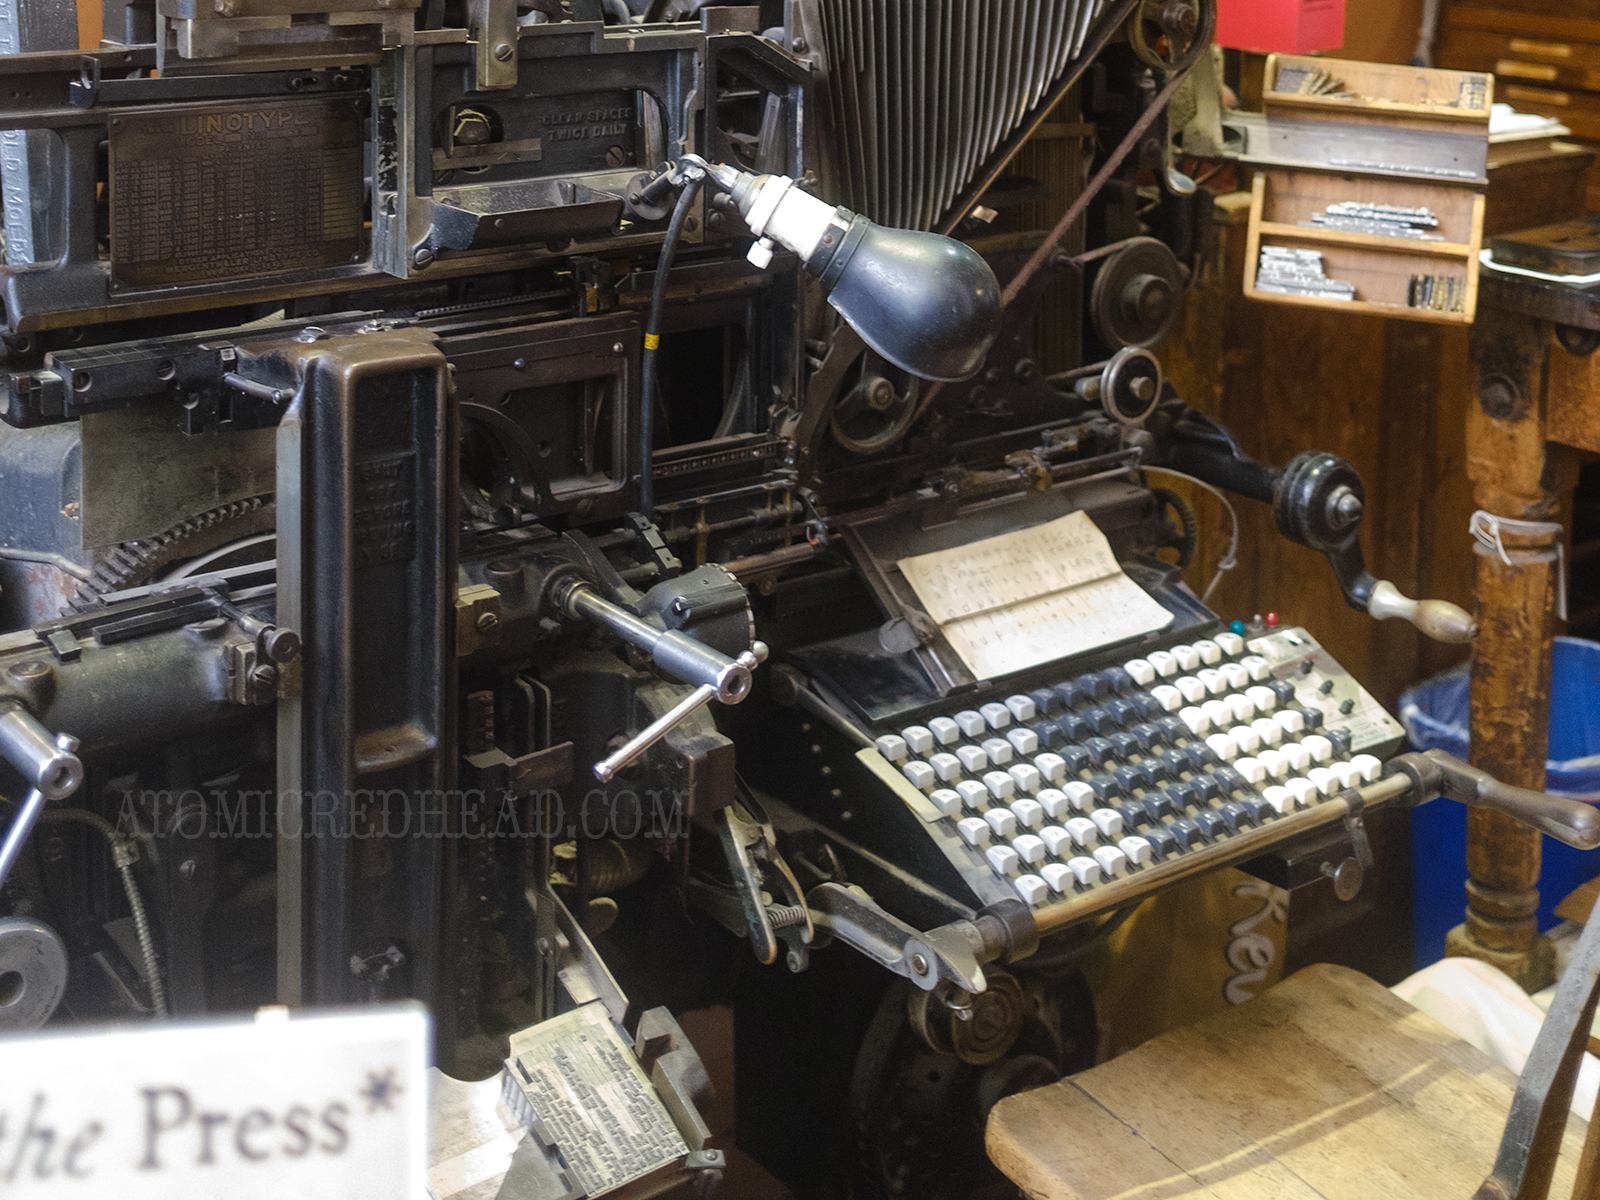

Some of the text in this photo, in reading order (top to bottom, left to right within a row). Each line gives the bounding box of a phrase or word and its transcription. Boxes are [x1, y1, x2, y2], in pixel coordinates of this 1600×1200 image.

[181, 111, 310, 134] LINOTYPE
[543, 106, 632, 126] CLEAR SPACES
[548, 122, 628, 142] TWICE DAILY
[0, 1091, 104, 1185] he
